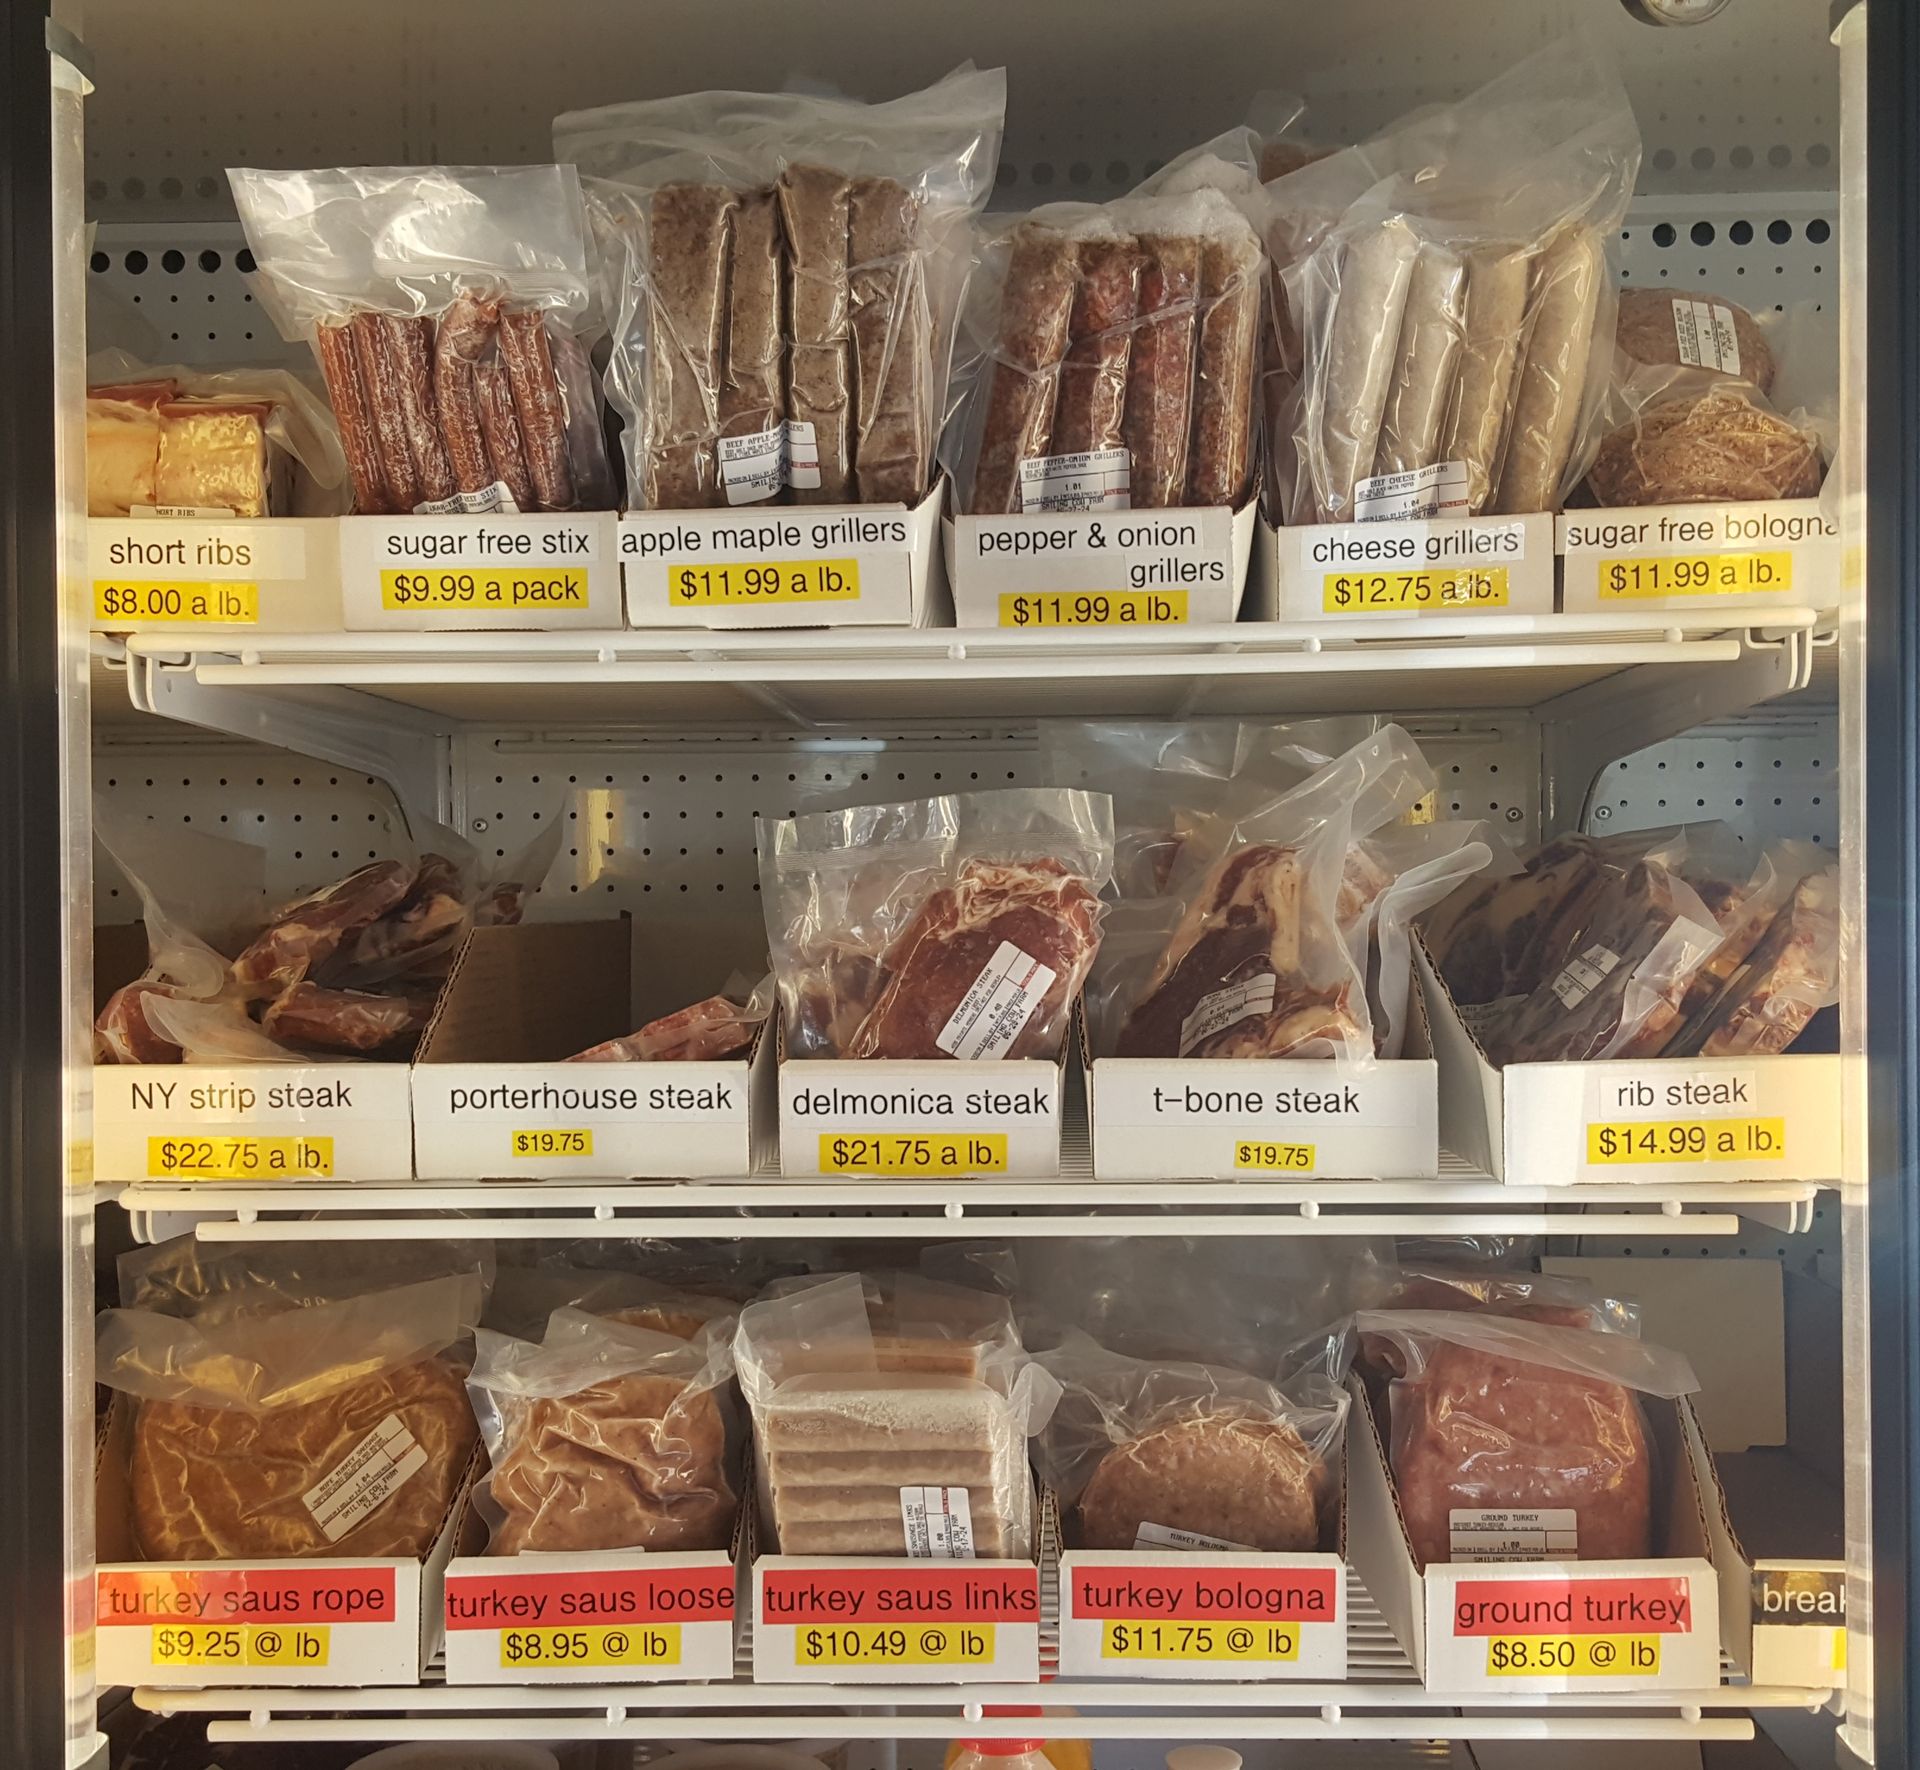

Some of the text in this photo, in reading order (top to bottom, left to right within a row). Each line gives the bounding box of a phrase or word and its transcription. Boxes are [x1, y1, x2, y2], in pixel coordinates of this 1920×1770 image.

[178, 509, 195, 517] RIBS
[388, 529, 589, 558] sugar free stix
[622, 517, 905, 556] apple maple grillers
[980, 521, 1194, 556] pepper & onion
[1313, 530, 1518, 562] cheese grillers
[1567, 524, 1649, 549] sugar
[1659, 517, 1713, 541] free
[110, 537, 251, 565] short ribs
[681, 567, 850, 600] $11.99 a lb.
[1131, 558, 1224, 588] grillers
[1610, 559, 1780, 593] $11.99 a lb.
[104, 589, 249, 617] $8.00 a lb.
[395, 574, 579, 604] $9.99 a pack
[1335, 574, 1498, 606] $12.75 a lb.
[1014, 596, 1178, 624] $11.99 a lb.
[987, 1023, 1008, 1051] SMILING
[1006, 1011, 1018, 1024] COW
[132, 1081, 352, 1113] NY strip steak
[451, 1082, 732, 1113] porterhouse steak
[793, 1088, 1049, 1115] delmonica steak
[1276, 1086, 1359, 1113] steak
[1619, 1078, 1747, 1106] rib steak
[162, 1142, 328, 1170] $22.75 a lb.
[518, 1133, 584, 1152] $19.75
[833, 1138, 999, 1167] $21.75 a lb.
[1240, 1146, 1308, 1166] $19.75
[1599, 1125, 1780, 1157] $14.99 a lb.
[341, 1495, 368, 1520] SMILING
[109, 1586, 384, 1617] turkey saus rope
[447, 1582, 734, 1620] turkey saus loose
[766, 1582, 1036, 1615] turkey saus links
[1083, 1581, 1325, 1614] turkey bologna
[1458, 1592, 1687, 1628] ground turkey
[159, 1630, 319, 1658] $9.25 @ lb
[507, 1632, 667, 1662] $8.95 @ lb
[807, 1630, 984, 1659] $10.49 @ lb
[1112, 1624, 1291, 1653] $11.75 @ lb
[1492, 1640, 1655, 1670] $8.50 @ lb
